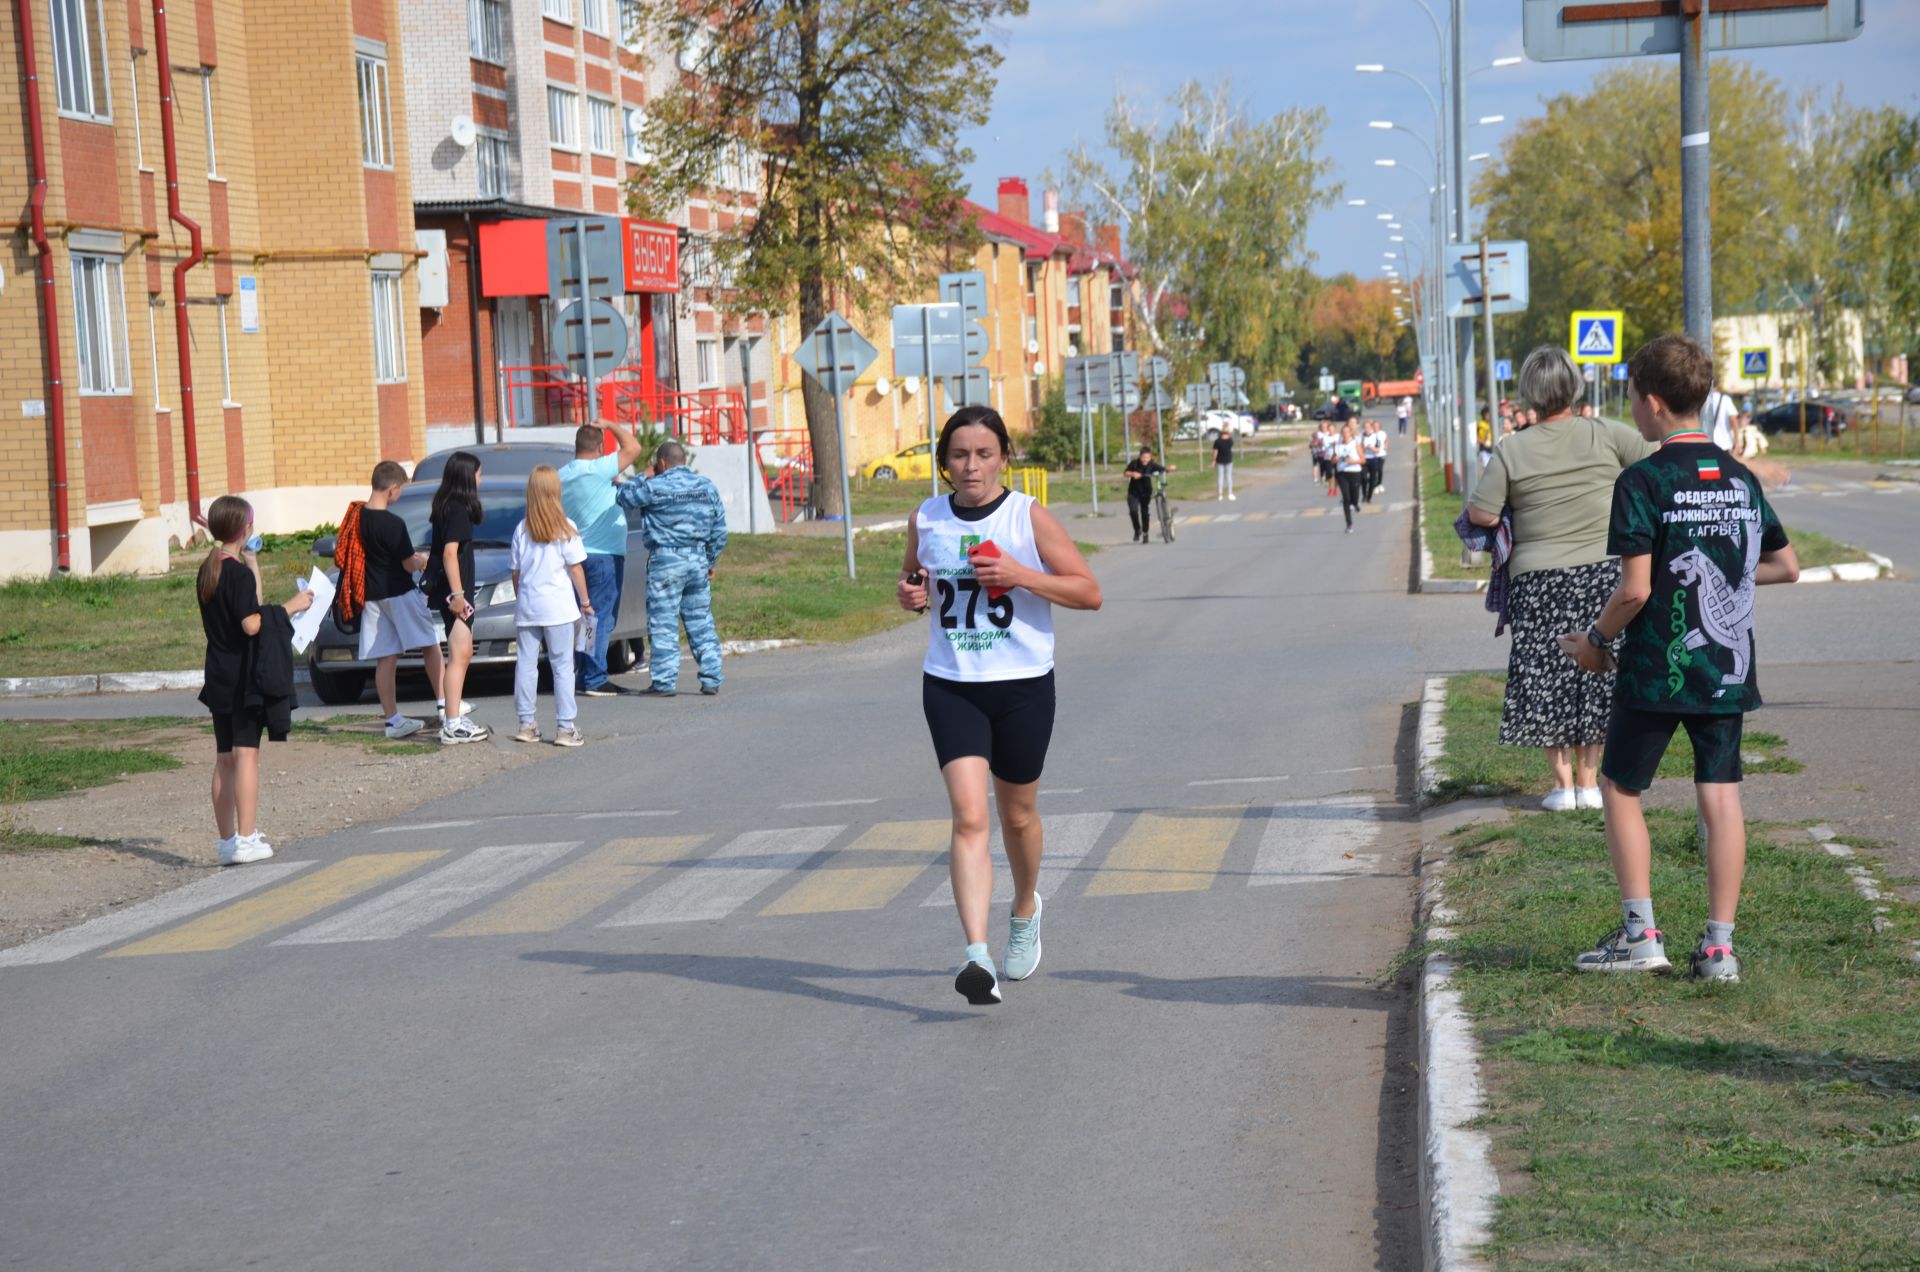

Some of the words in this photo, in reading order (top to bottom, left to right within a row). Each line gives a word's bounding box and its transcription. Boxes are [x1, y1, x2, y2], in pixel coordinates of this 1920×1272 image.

[633, 232, 671, 275] ВЫБОР
[1673, 489, 1745, 505] ФЕДЕРАЦИ
[937, 578, 1014, 629] 275
